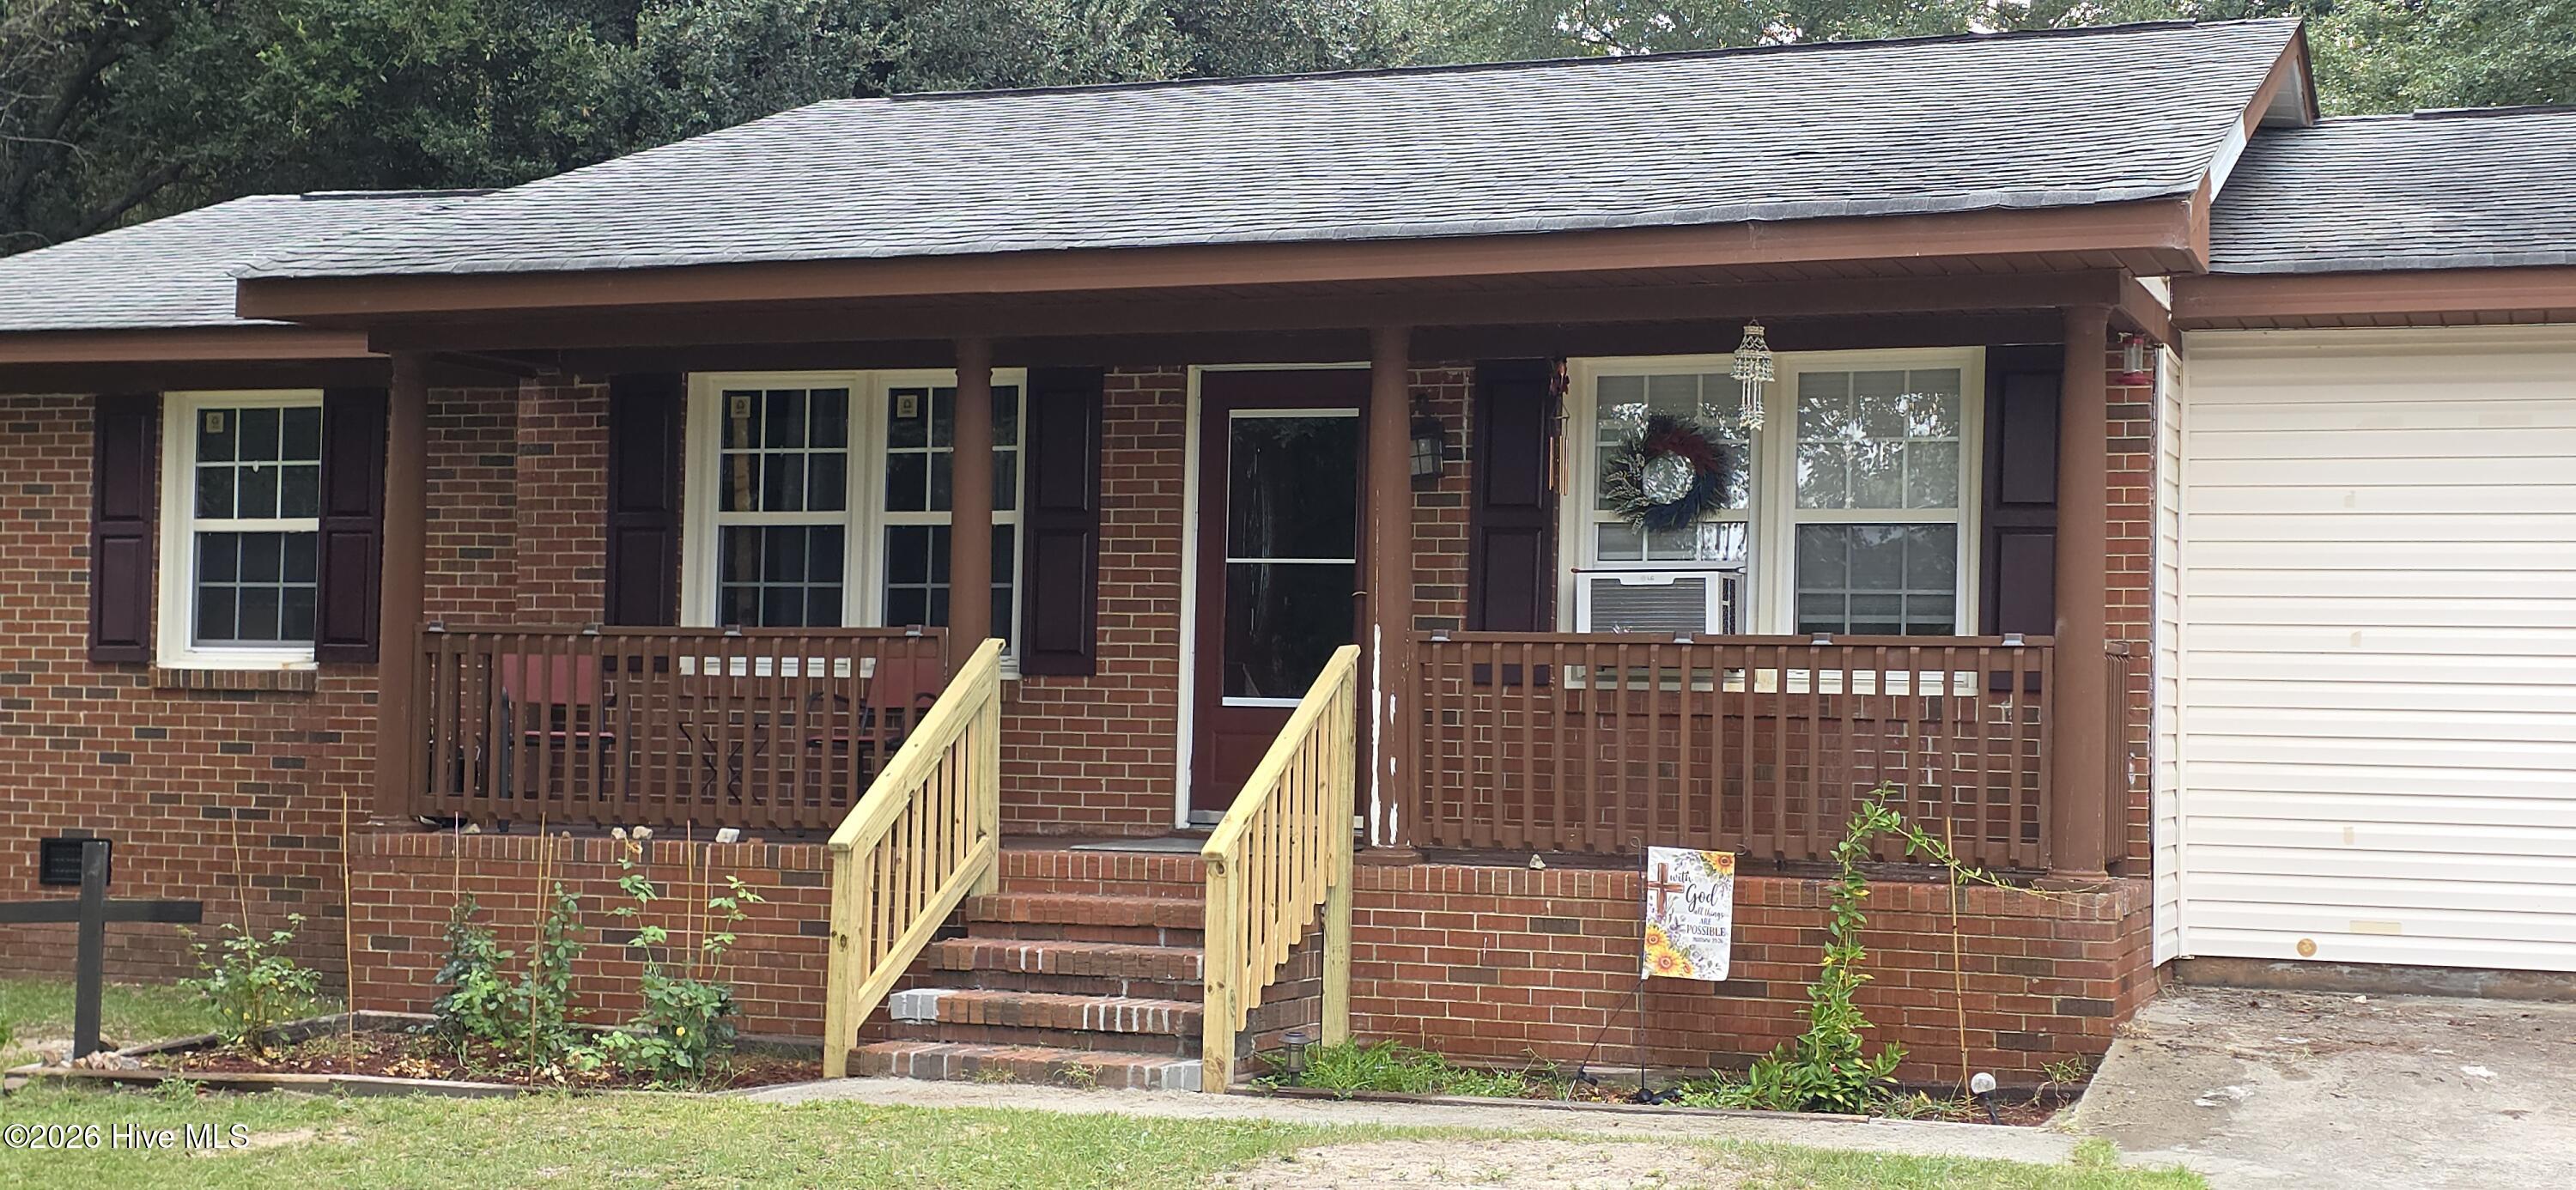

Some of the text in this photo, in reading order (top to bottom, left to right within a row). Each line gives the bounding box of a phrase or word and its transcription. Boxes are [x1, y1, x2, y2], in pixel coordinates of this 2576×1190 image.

[1669, 871, 1692, 883] with
[1686, 883, 1718, 913] God
[1686, 924, 1726, 937] POSSIBLE
